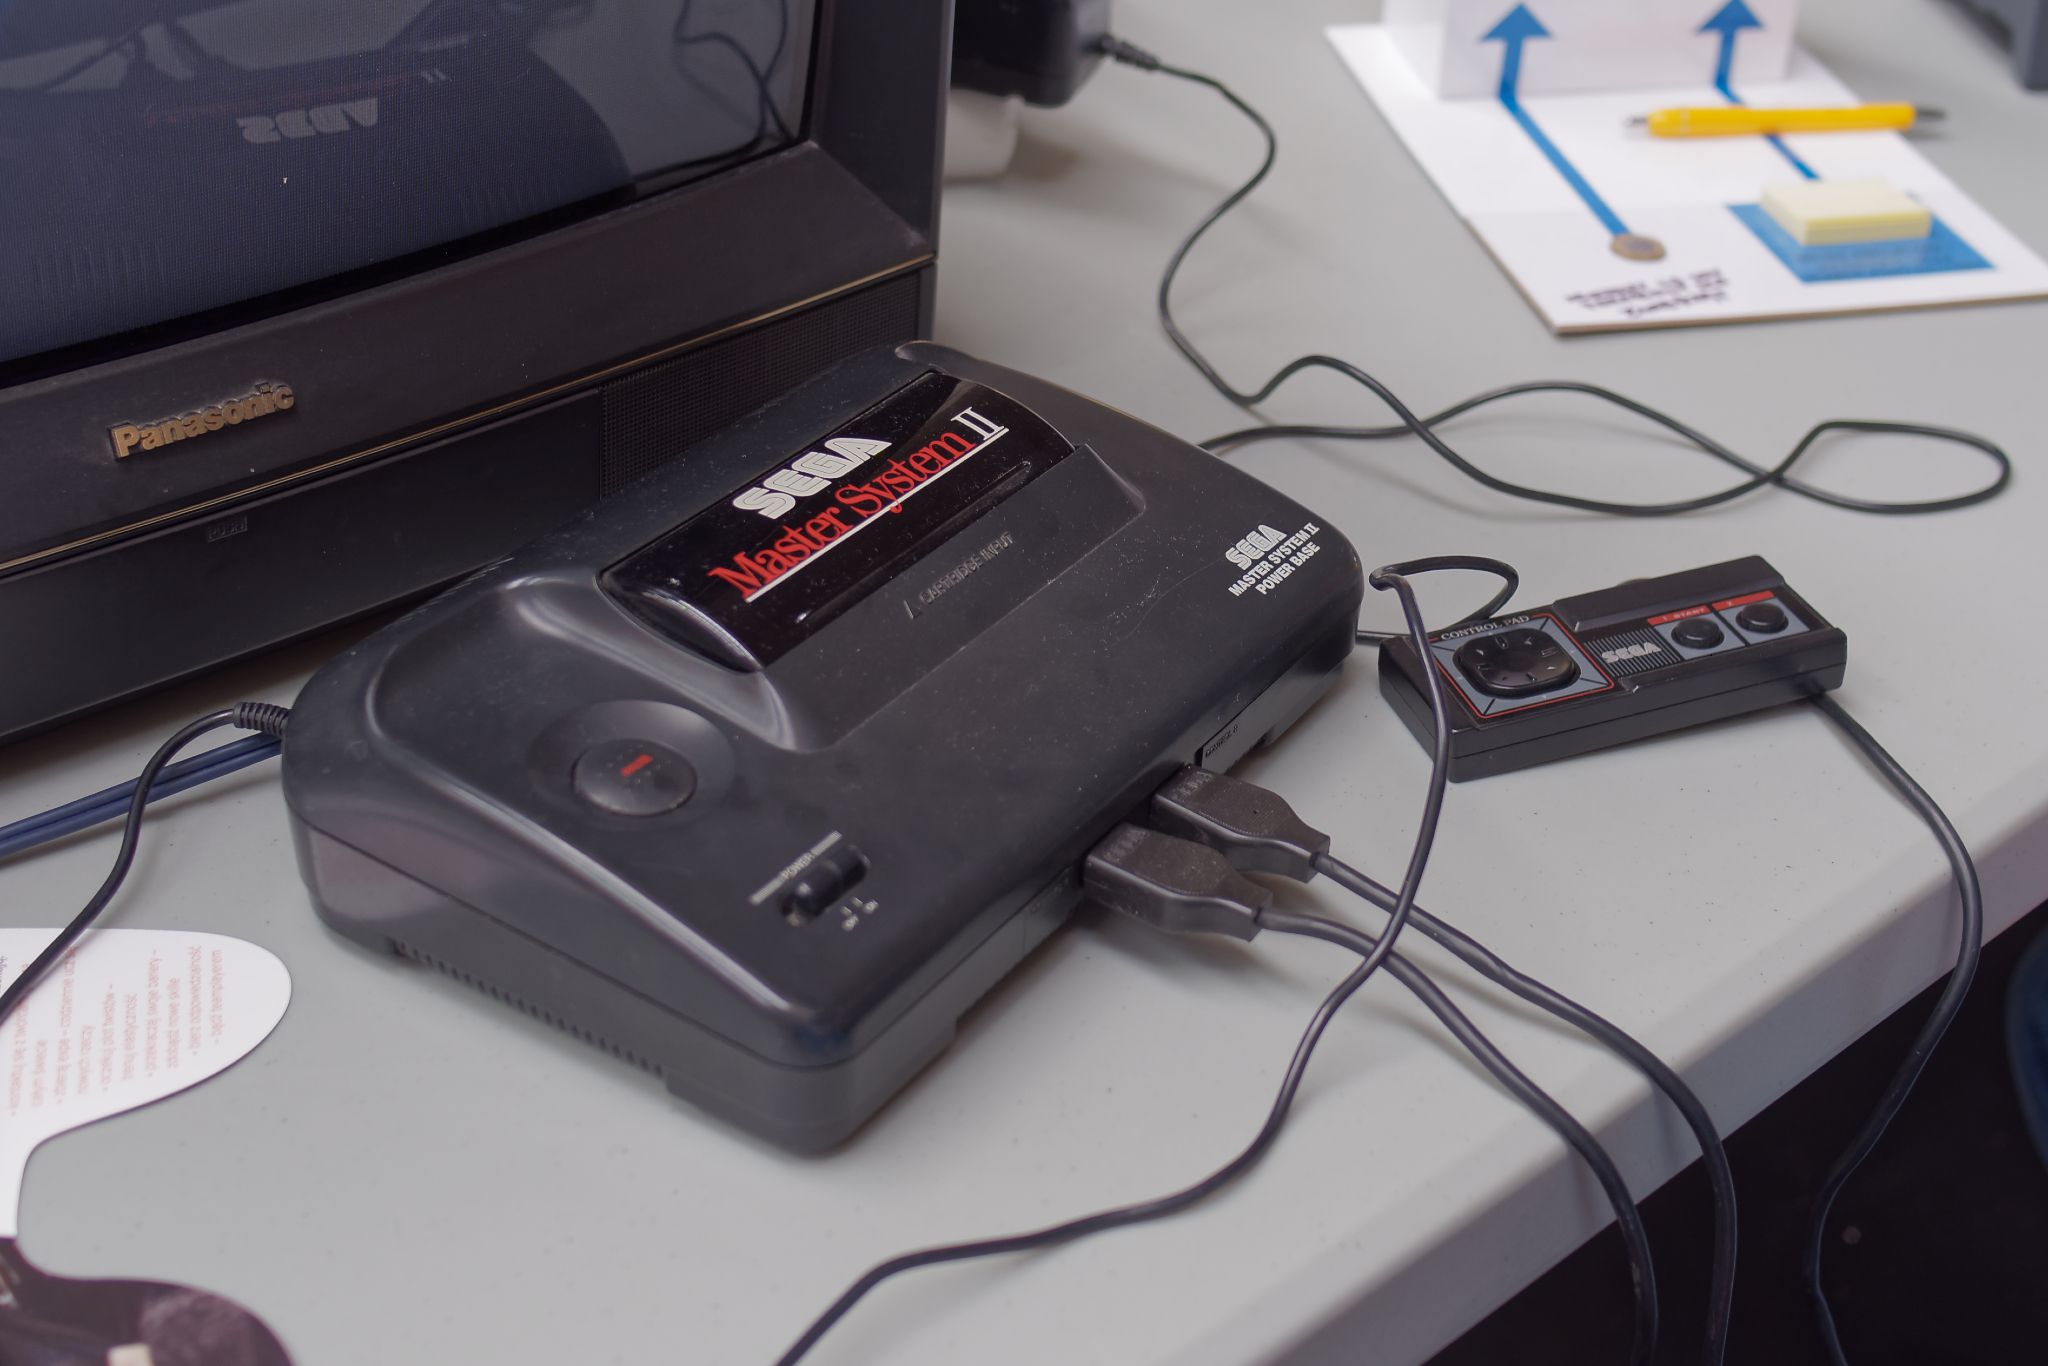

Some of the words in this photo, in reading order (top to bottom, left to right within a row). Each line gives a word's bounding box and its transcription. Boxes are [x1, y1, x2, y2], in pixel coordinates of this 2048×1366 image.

[110, 384, 296, 459] Panasonic
[706, 506, 853, 600] Master
[835, 432, 977, 513] System
[950, 407, 1004, 441] II
[733, 437, 892, 520] SEGA
[920, 554, 982, 604] CARTRIDGE
[980, 531, 1013, 560] INPUT
[1225, 524, 1287, 570] SEGA
[1228, 559, 1275, 596] MASTER
[1268, 532, 1309, 565] SYSTEM
[1303, 522, 1320, 539] II
[1254, 563, 1296, 595] POWER
[1289, 542, 1321, 567] BASE
[1440, 623, 1503, 640] CONTROL
[1503, 615, 1531, 628] PAD
[1673, 608, 1706, 620] START
[1601, 641, 1662, 664] SEGA
[780, 852, 817, 880] POWER
